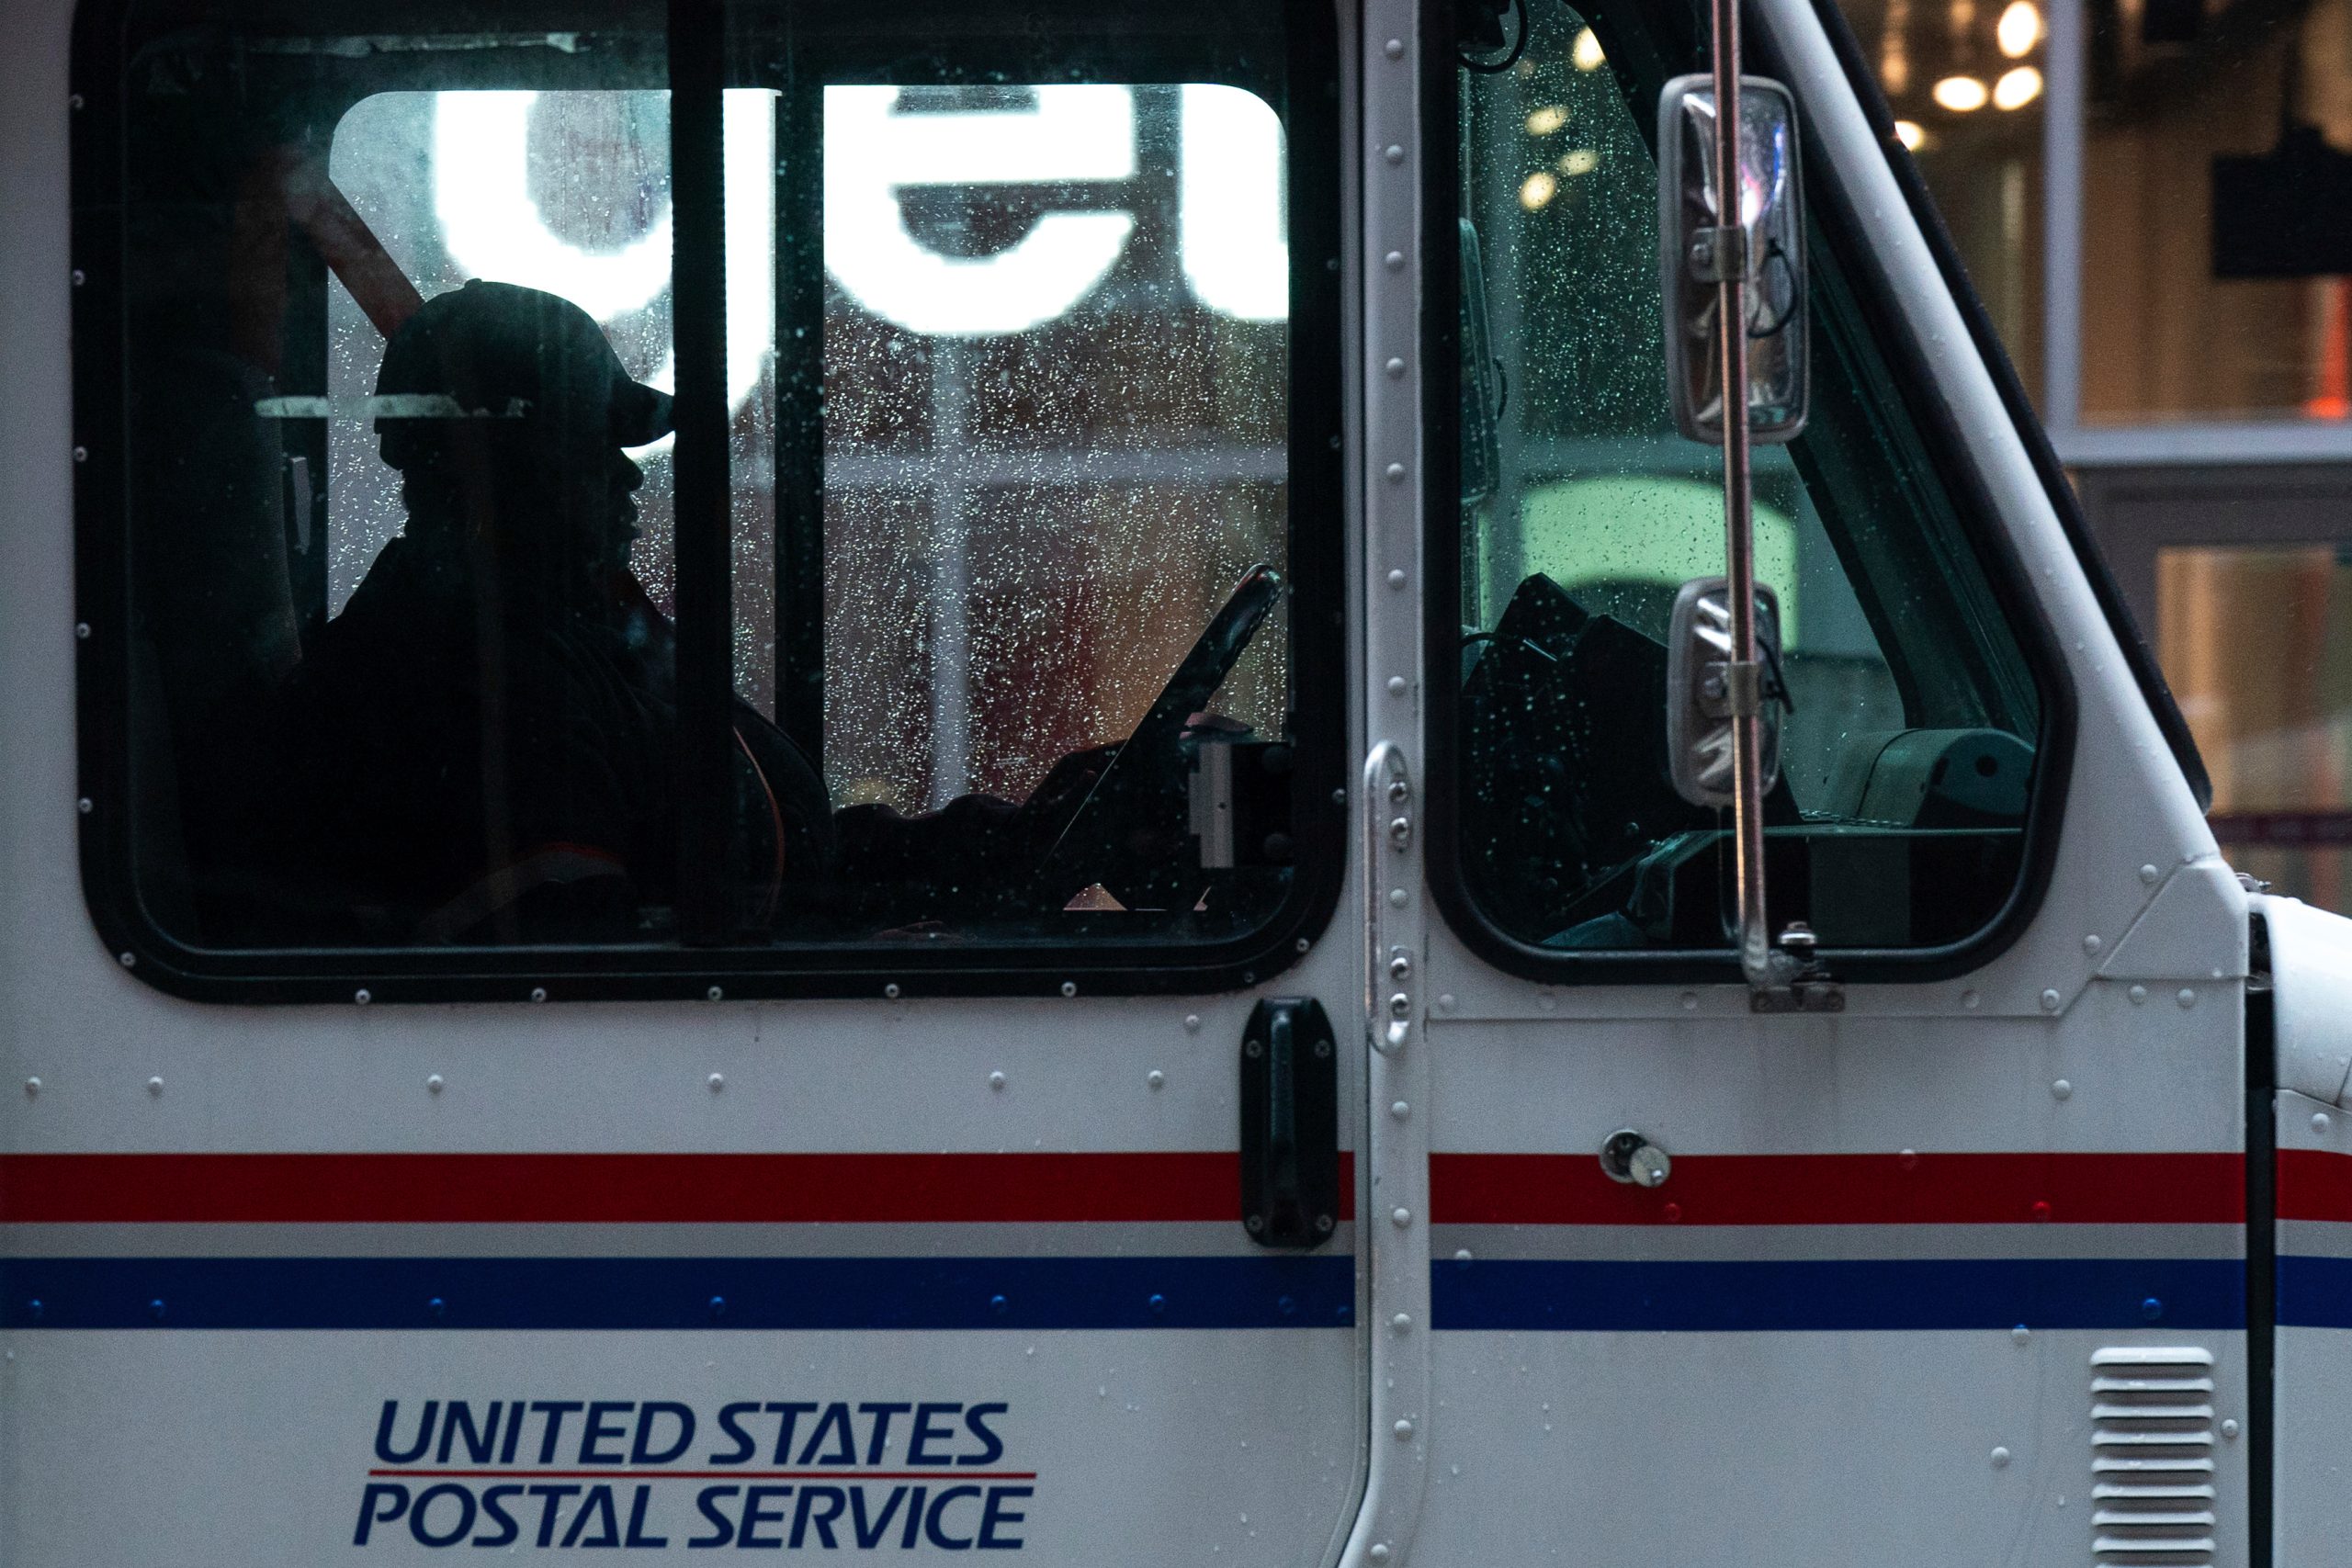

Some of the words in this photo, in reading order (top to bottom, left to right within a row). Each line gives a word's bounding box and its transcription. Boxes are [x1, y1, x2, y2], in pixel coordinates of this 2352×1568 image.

[374, 1400, 696, 1465] UNITED
[708, 1401, 1009, 1466] STATES
[353, 1483, 668, 1549] POSTAL
[687, 1485, 1034, 1551] SERVICE
